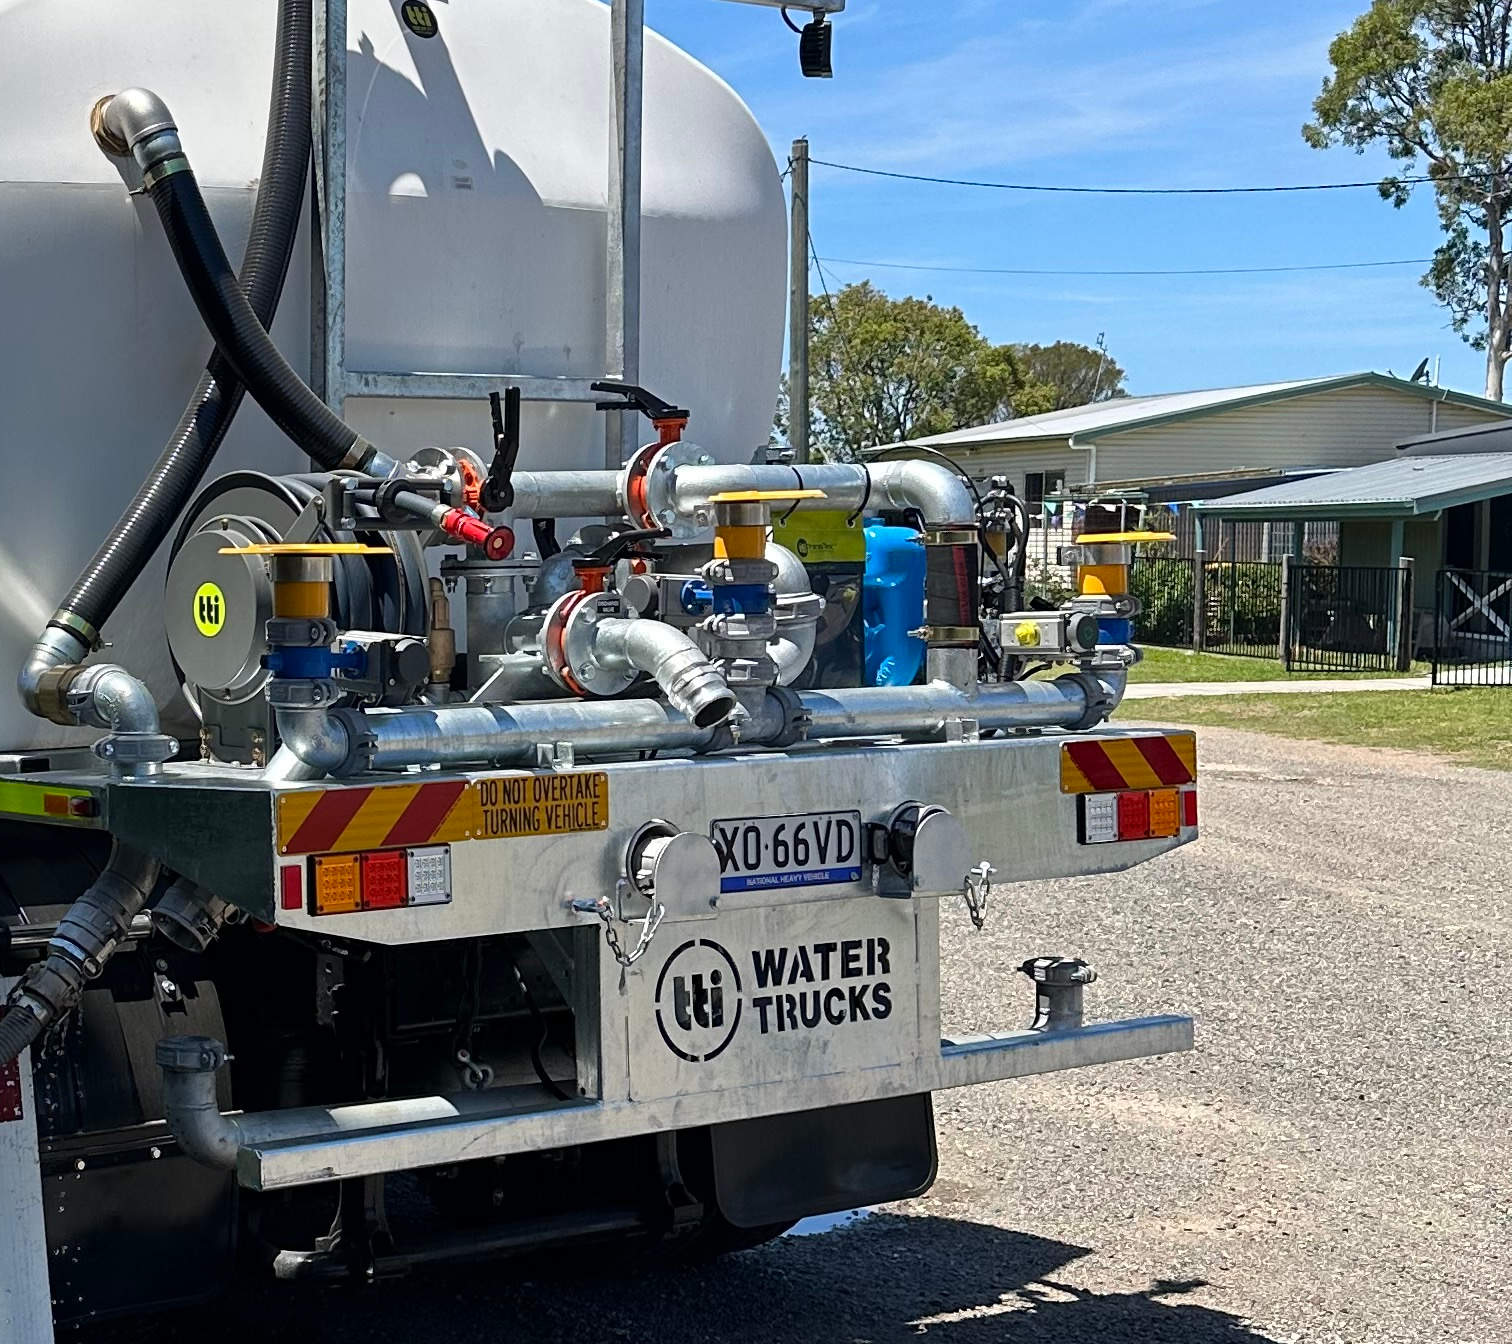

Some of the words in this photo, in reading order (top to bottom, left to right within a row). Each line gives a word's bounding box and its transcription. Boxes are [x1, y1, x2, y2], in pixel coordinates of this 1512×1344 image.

[199, 595, 220, 625] tti
[480, 780, 498, 807] DO
[503, 778, 528, 805] NOT
[533, 773, 601, 803] OVERTAKE
[483, 806, 539, 835] TURNING
[545, 801, 600, 830] VEHICLE
[746, 876, 779, 886] NATIONAL
[780, 874, 803, 883] HEAVY
[803, 872, 830, 882] VEHICLE
[752, 937, 891, 988] WATER
[673, 969, 724, 1031] tti
[752, 982, 892, 1034] TRUCKS
